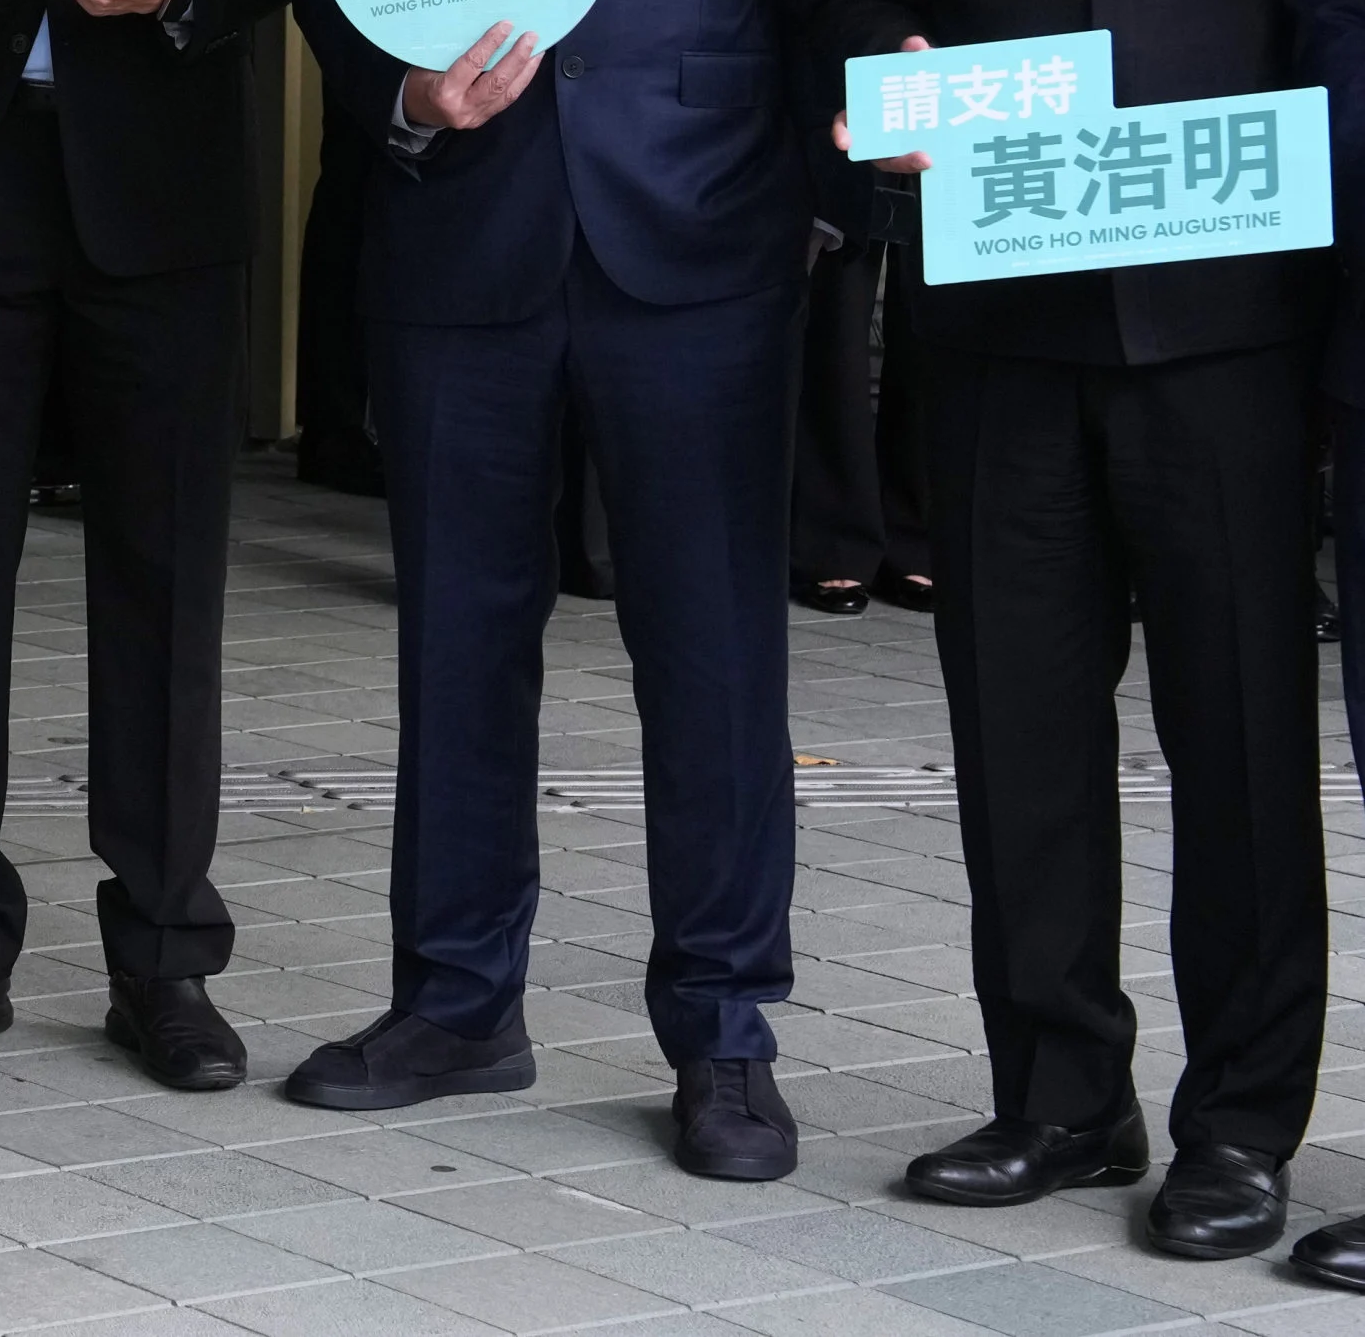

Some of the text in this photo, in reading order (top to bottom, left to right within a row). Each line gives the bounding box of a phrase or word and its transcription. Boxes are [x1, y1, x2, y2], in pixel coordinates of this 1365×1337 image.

[370, 0, 418, 17] WONG
[880, 54, 1078, 132] 請支持
[971, 109, 1279, 229] 黃浩明
[973, 234, 1044, 257] WONG
[1049, 229, 1083, 250] HO
[1088, 224, 1148, 246] MING
[1153, 210, 1282, 239] AUGUSTINE
